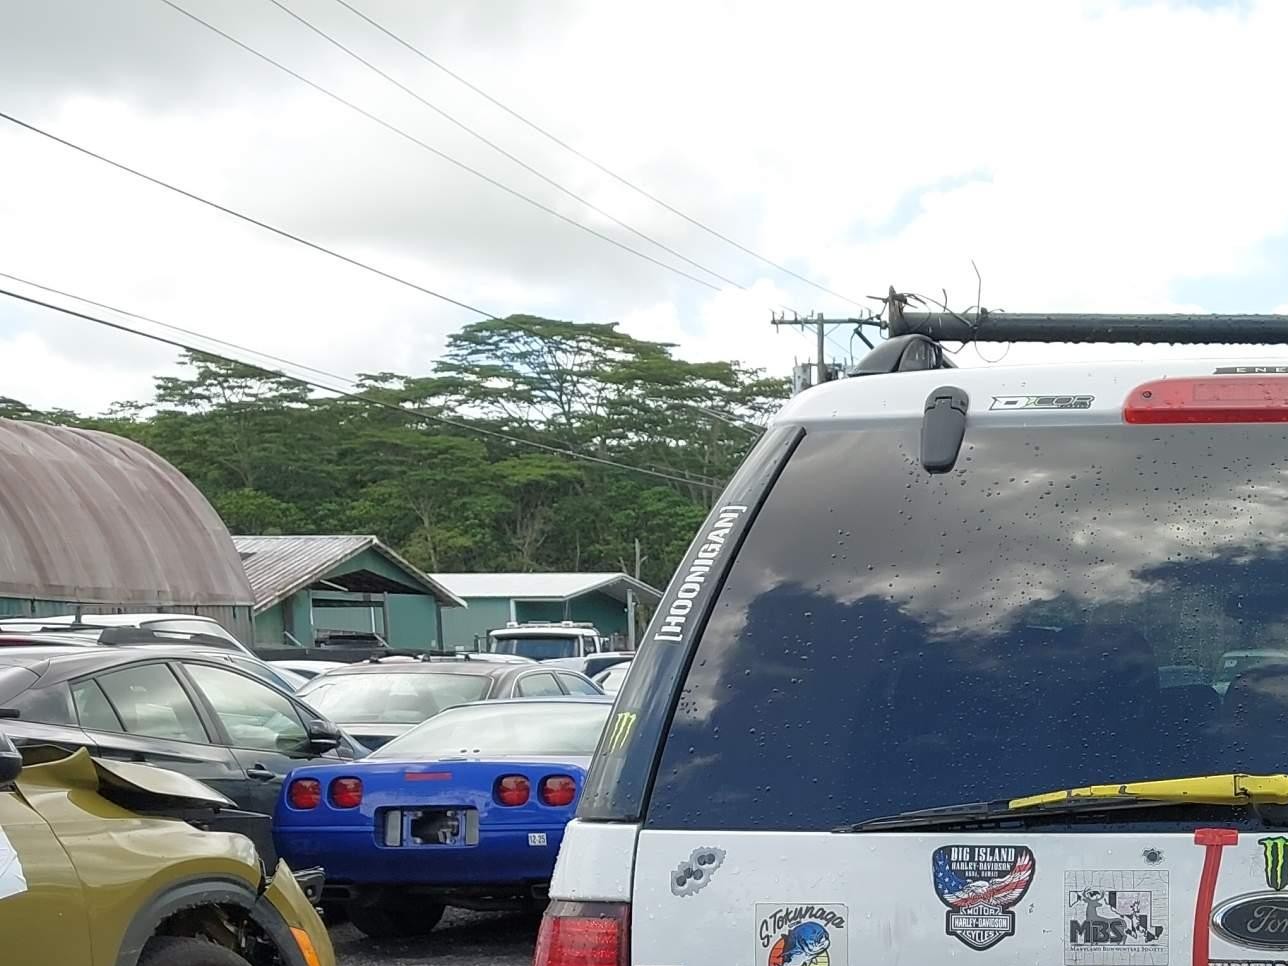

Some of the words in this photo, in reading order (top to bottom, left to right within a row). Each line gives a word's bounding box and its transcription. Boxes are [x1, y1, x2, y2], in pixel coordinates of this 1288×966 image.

[951, 847, 970, 862] BIG
[974, 847, 1016, 862] ISLAND
[966, 907, 997, 915] MOTOR
[954, 918, 1007, 928] HARLEY-DAVIDSON
[966, 930, 995, 940] CYCLES
[1070, 920, 1126, 943] MBS
